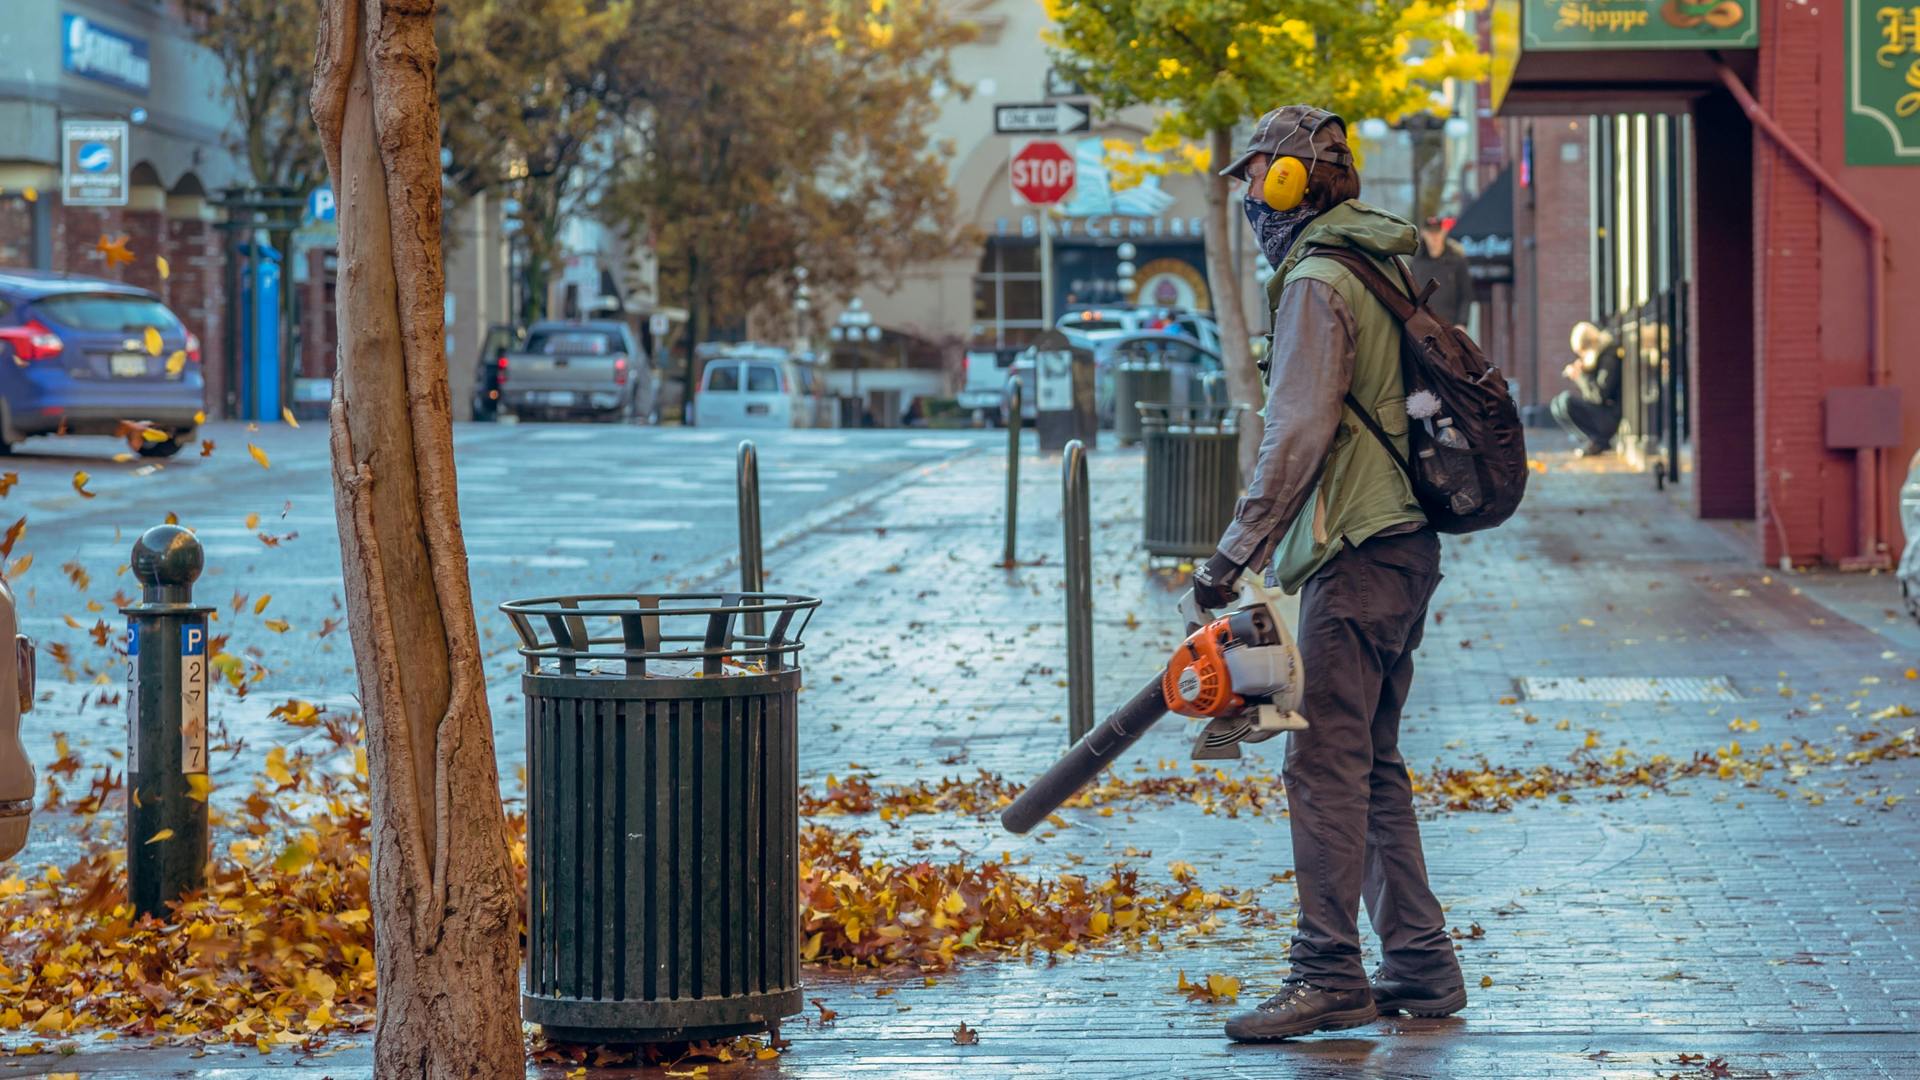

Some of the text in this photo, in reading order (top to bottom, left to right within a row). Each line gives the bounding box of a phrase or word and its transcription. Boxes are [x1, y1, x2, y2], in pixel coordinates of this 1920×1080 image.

[1553, 3, 1648, 32] Shoppe
[1012, 158, 1074, 187] STOP
[188, 629, 202, 652] P
